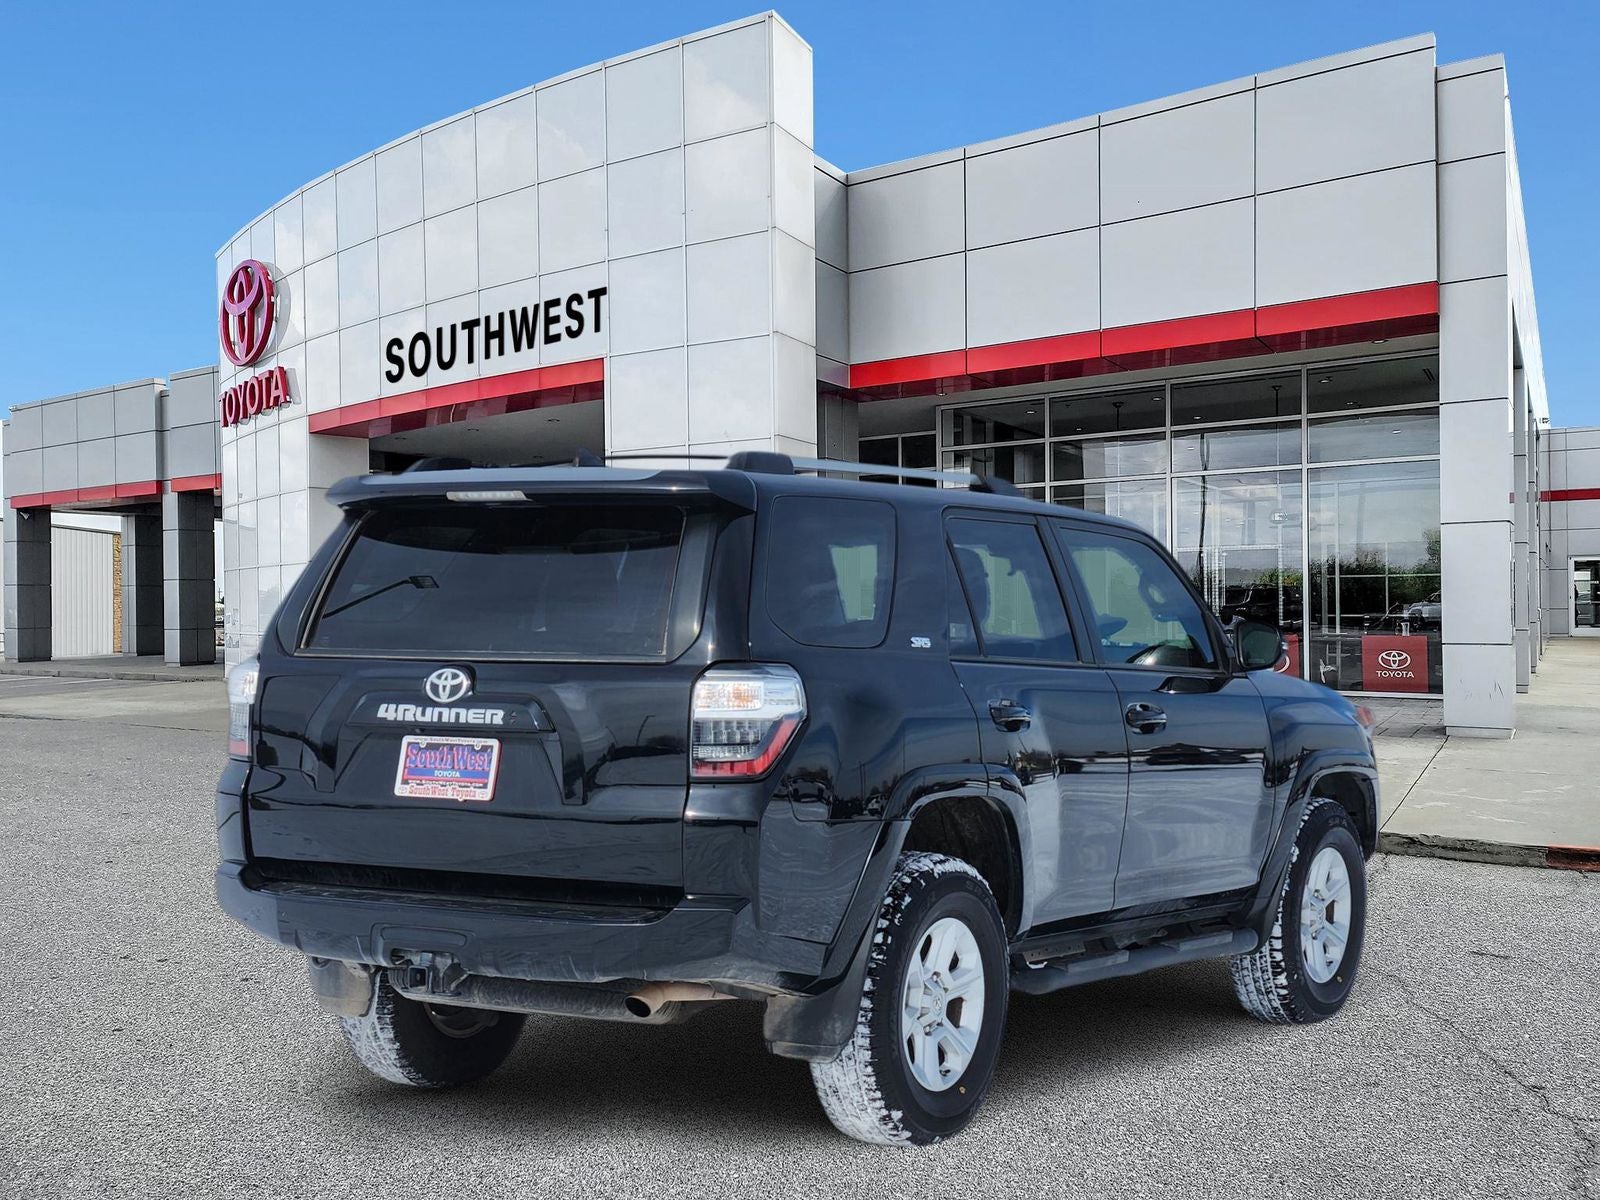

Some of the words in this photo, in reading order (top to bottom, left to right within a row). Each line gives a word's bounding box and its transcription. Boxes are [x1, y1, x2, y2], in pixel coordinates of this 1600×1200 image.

[385, 286, 608, 384] SOUTHWEST
[219, 366, 291, 428] TOYOTA
[1375, 670, 1415, 678] TOYOTA
[376, 703, 506, 725] 4RUNNER
[434, 770, 461, 778] TOYOTA
[451, 788, 476, 799] Toyota
